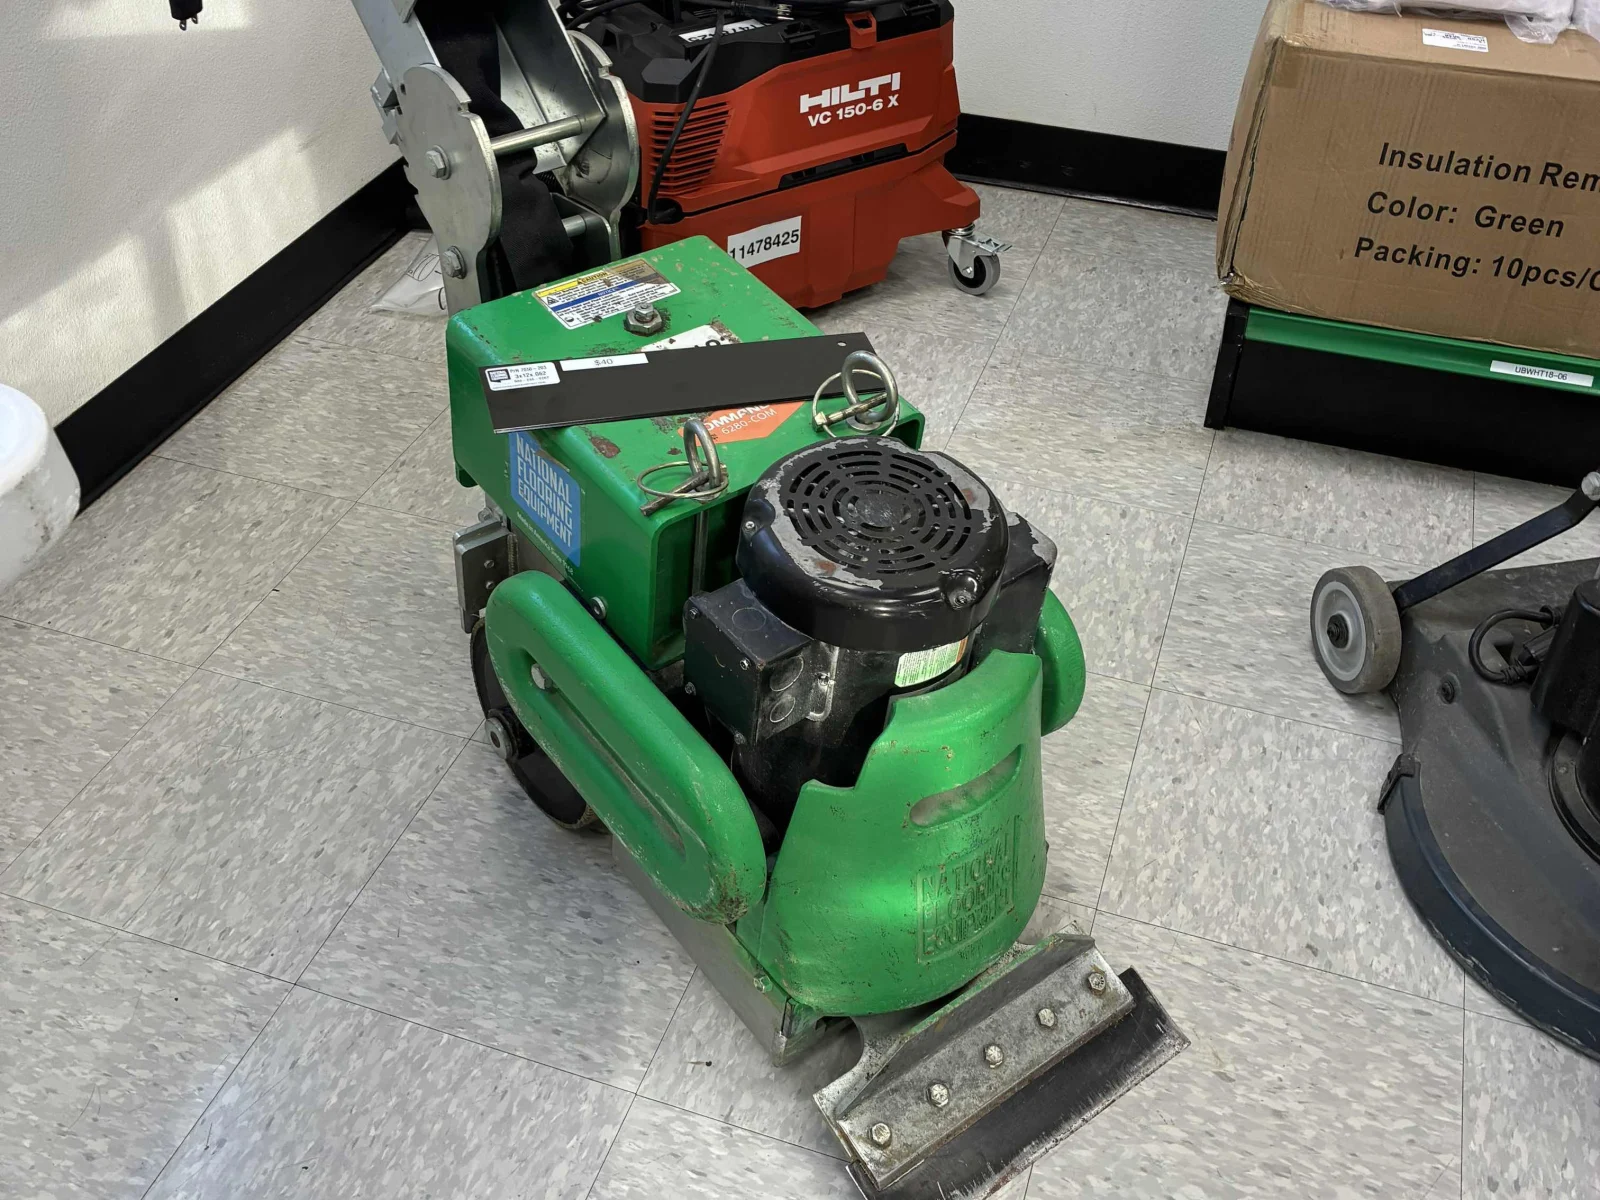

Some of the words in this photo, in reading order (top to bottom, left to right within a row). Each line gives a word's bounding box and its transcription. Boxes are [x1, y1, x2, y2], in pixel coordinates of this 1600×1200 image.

[800, 72, 900, 113] HILTI
[807, 111, 832, 127] VC
[836, 98, 884, 120] 150-6
[887, 93, 899, 108] X
[1379, 142, 1532, 184] Insulation
[1367, 191, 1458, 224] Color:
[1474, 205, 1564, 238] Green
[730, 229, 800, 260] 11478425
[1354, 237, 1482, 278] Packing:
[594, 358, 614, 366] $40
[1514, 366, 1568, 381] UBWHT18-06
[703, 404, 771, 432] OMMAN
[721, 408, 777, 435] 6280-COM
[516, 433, 573, 508] NATIONAL
[517, 455, 573, 530] FLOORING
[517, 477, 573, 548] EQUIPMENT
